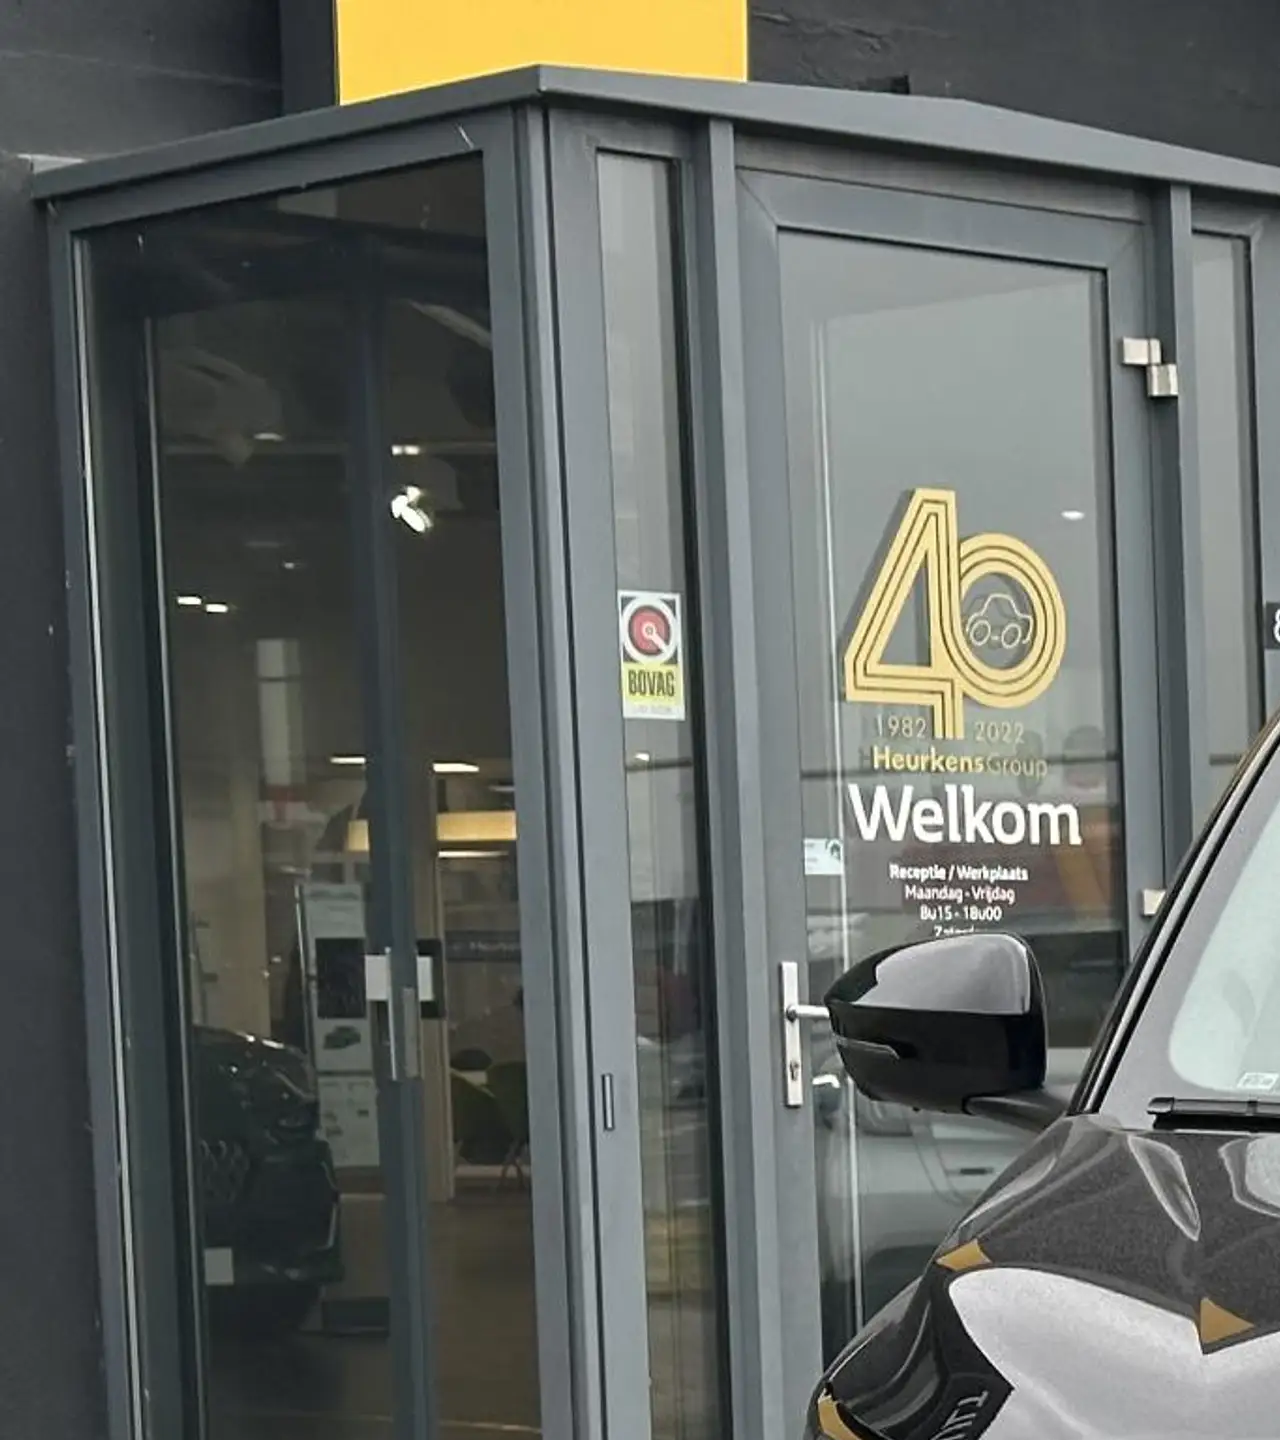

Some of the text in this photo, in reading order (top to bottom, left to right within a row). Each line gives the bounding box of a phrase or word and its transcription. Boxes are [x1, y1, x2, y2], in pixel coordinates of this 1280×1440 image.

[845, 488, 1066, 739] 40
[628, 669, 675, 697] BOVAG
[877, 713, 1025, 744] 1982 2022
[848, 783, 1083, 845] Welkom
[889, 863, 946, 881] Receptie
[955, 865, 1029, 883] Werkplaats
[904, 884, 963, 902] Maandag
[972, 885, 1016, 904] Vrijdag
